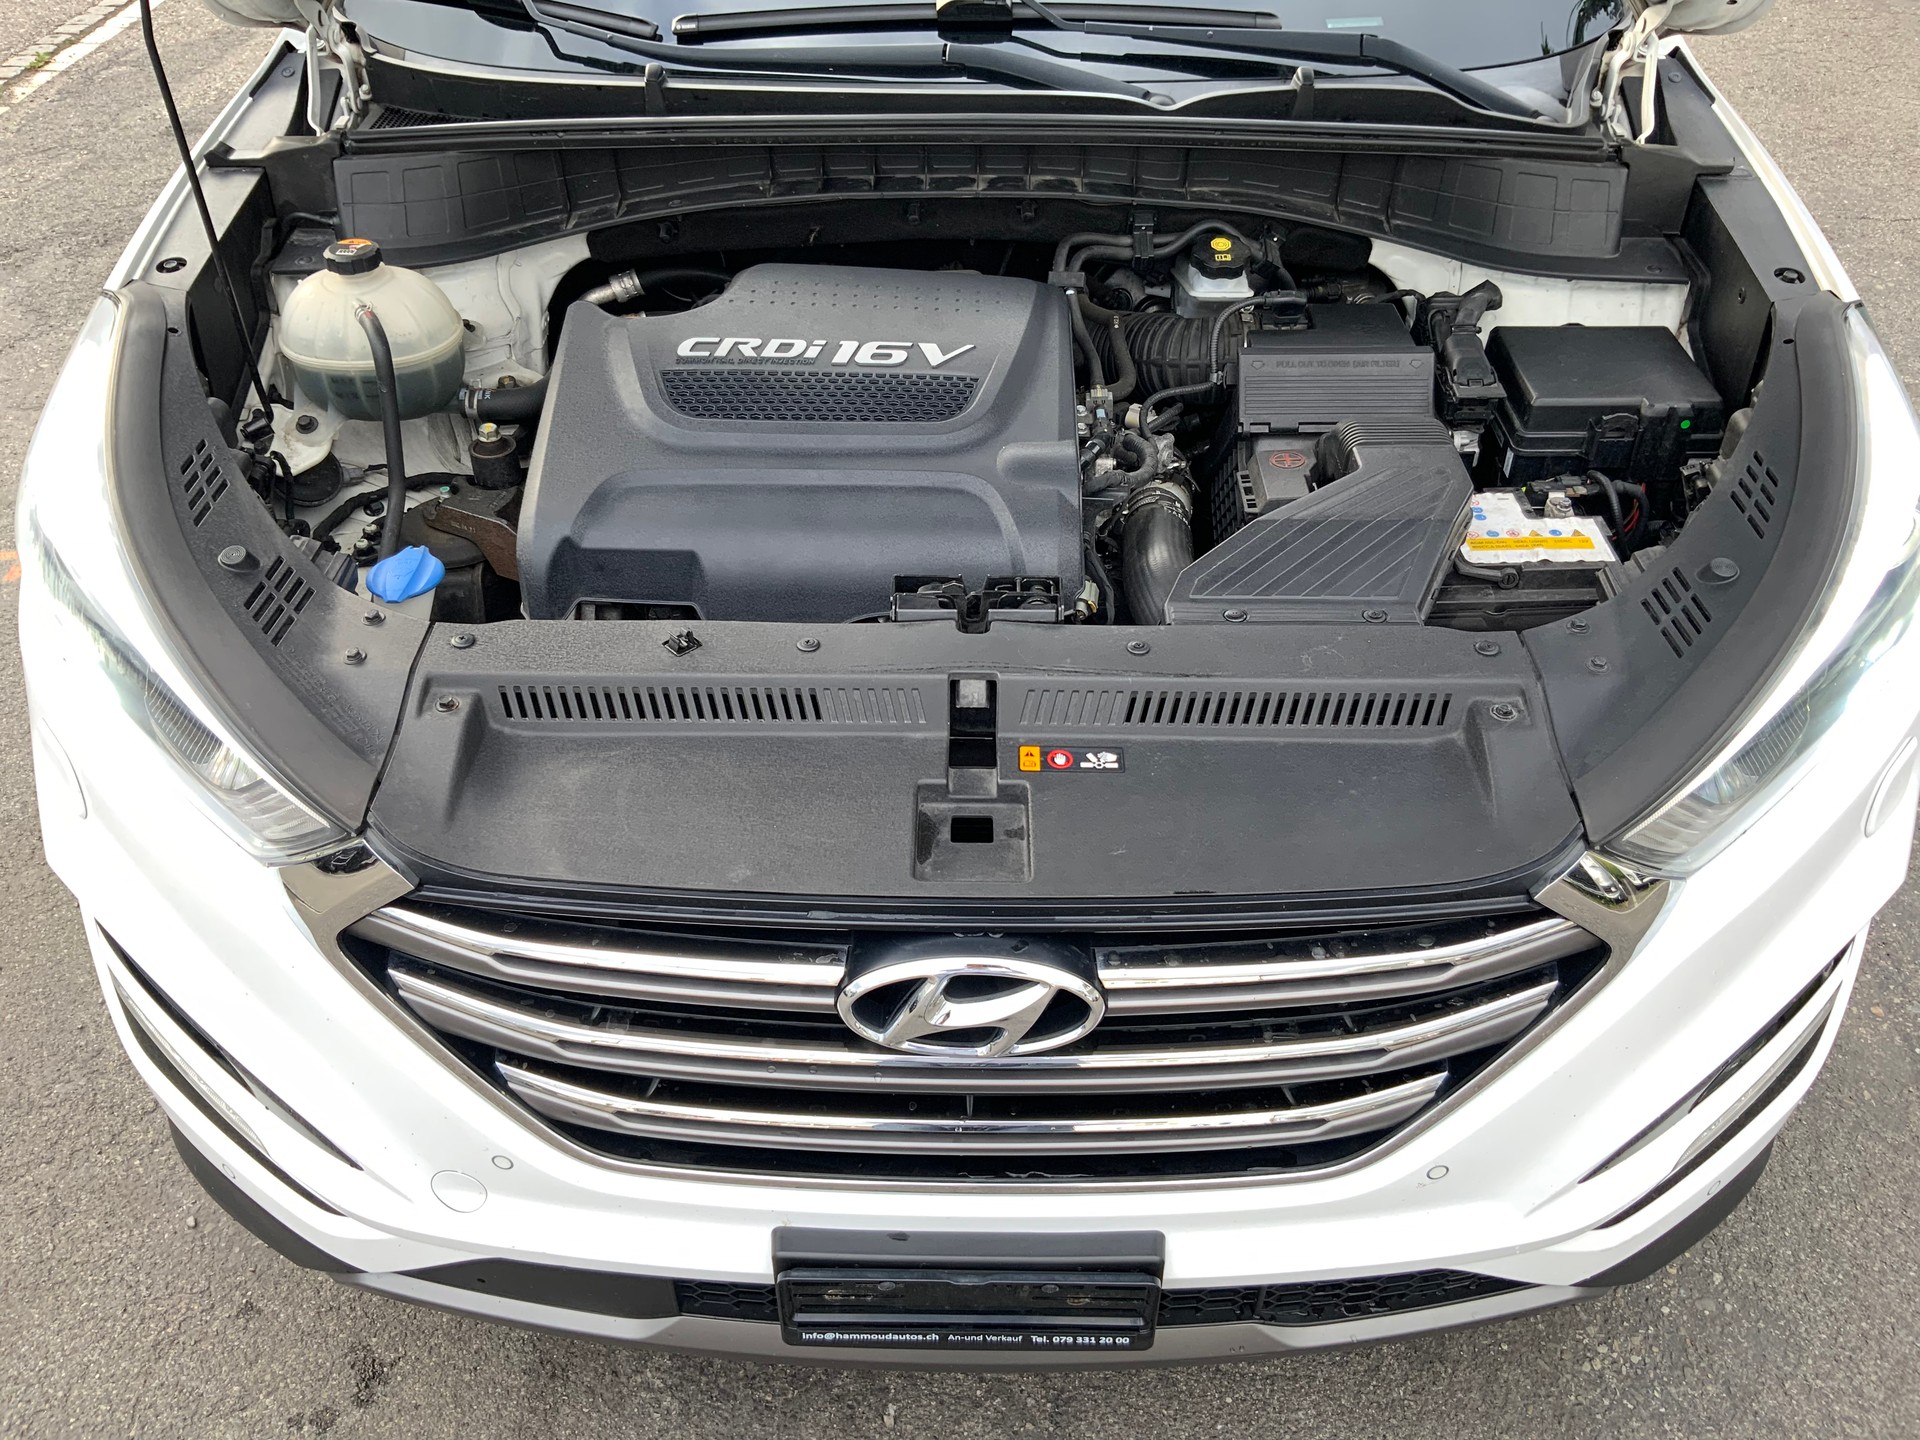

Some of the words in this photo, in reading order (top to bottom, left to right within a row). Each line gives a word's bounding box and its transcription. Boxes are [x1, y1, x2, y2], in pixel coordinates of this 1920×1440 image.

[676, 337, 828, 359] CRDi
[947, 1334, 983, 1342] An-und
[984, 1334, 1024, 1343] Verkauf
[1030, 1335, 1050, 1344] Tel.
[1052, 1336, 1074, 1345] 079
[1075, 1336, 1097, 1345] 331
[1098, 1336, 1114, 1345] 20
[1114, 1336, 1131, 1345] 00
